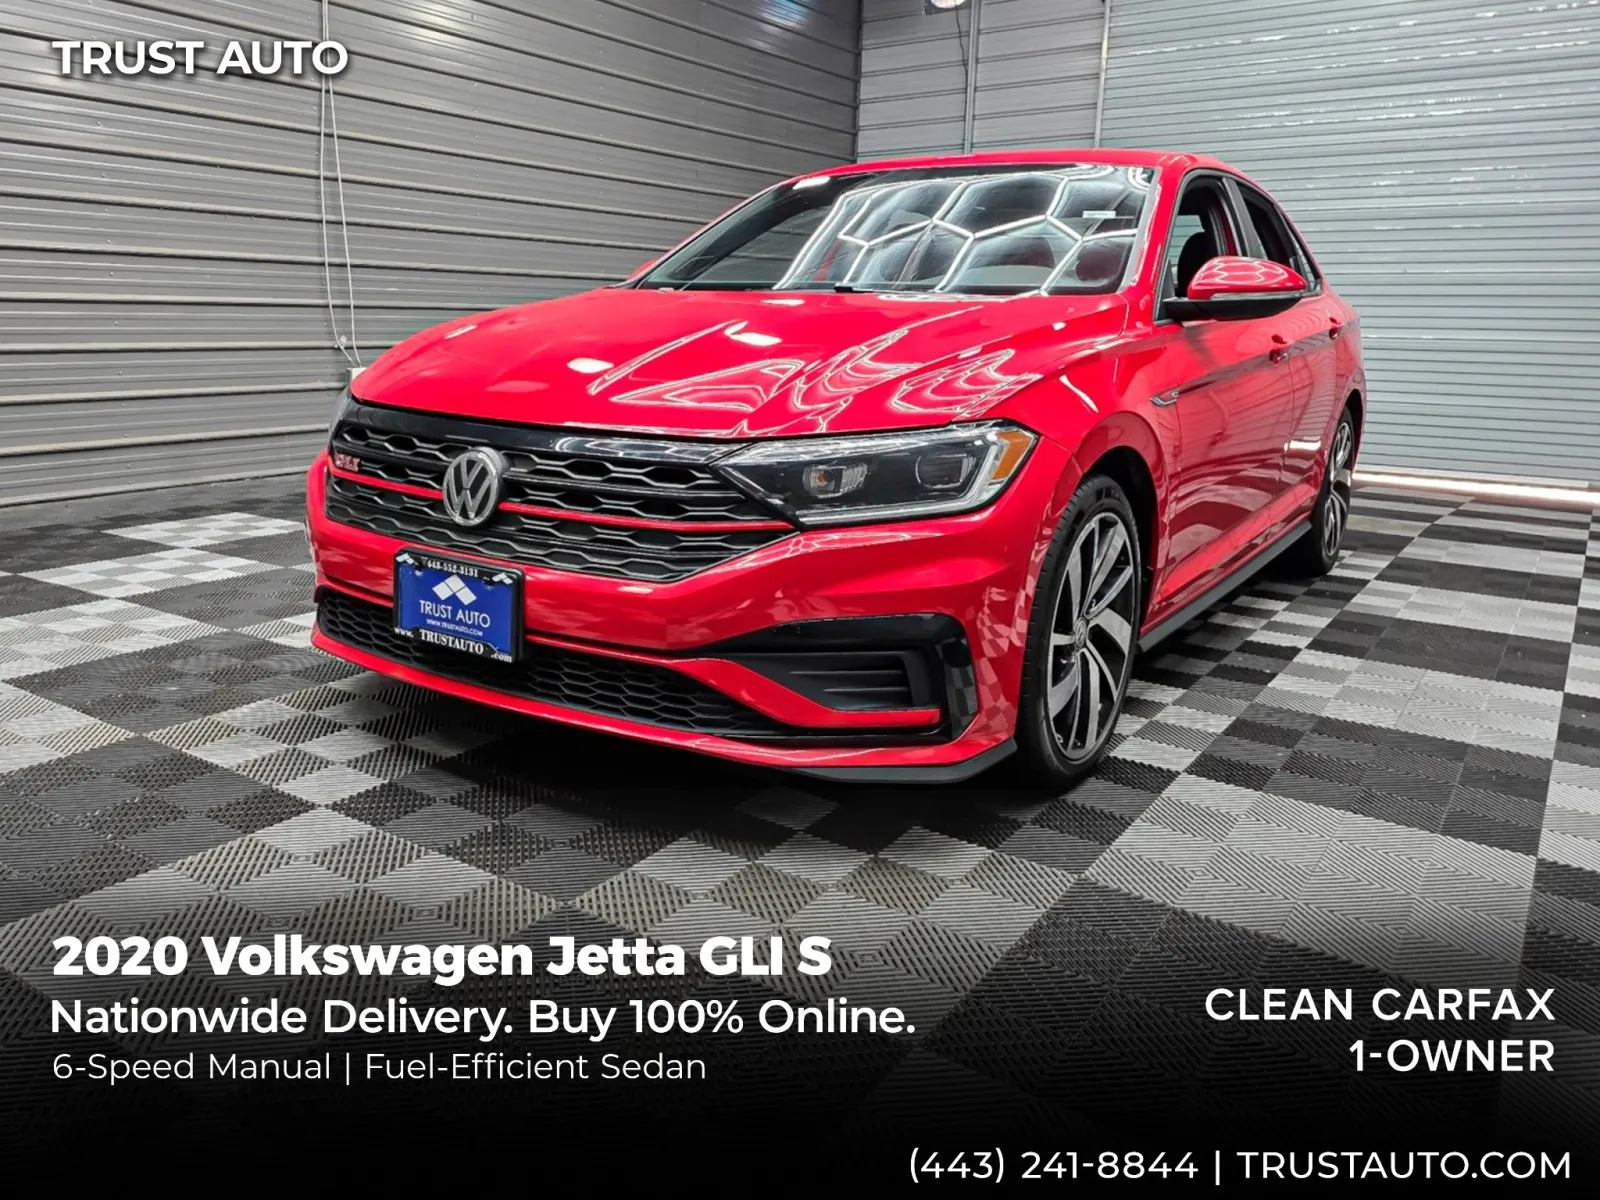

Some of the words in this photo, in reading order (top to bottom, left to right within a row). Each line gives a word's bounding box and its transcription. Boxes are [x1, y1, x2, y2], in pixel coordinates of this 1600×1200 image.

[419, 599, 453, 620] TRUST
[455, 608, 491, 628] AUTO
[419, 628, 484, 655] TRUSTAUTO
[490, 651, 513, 663] .com
